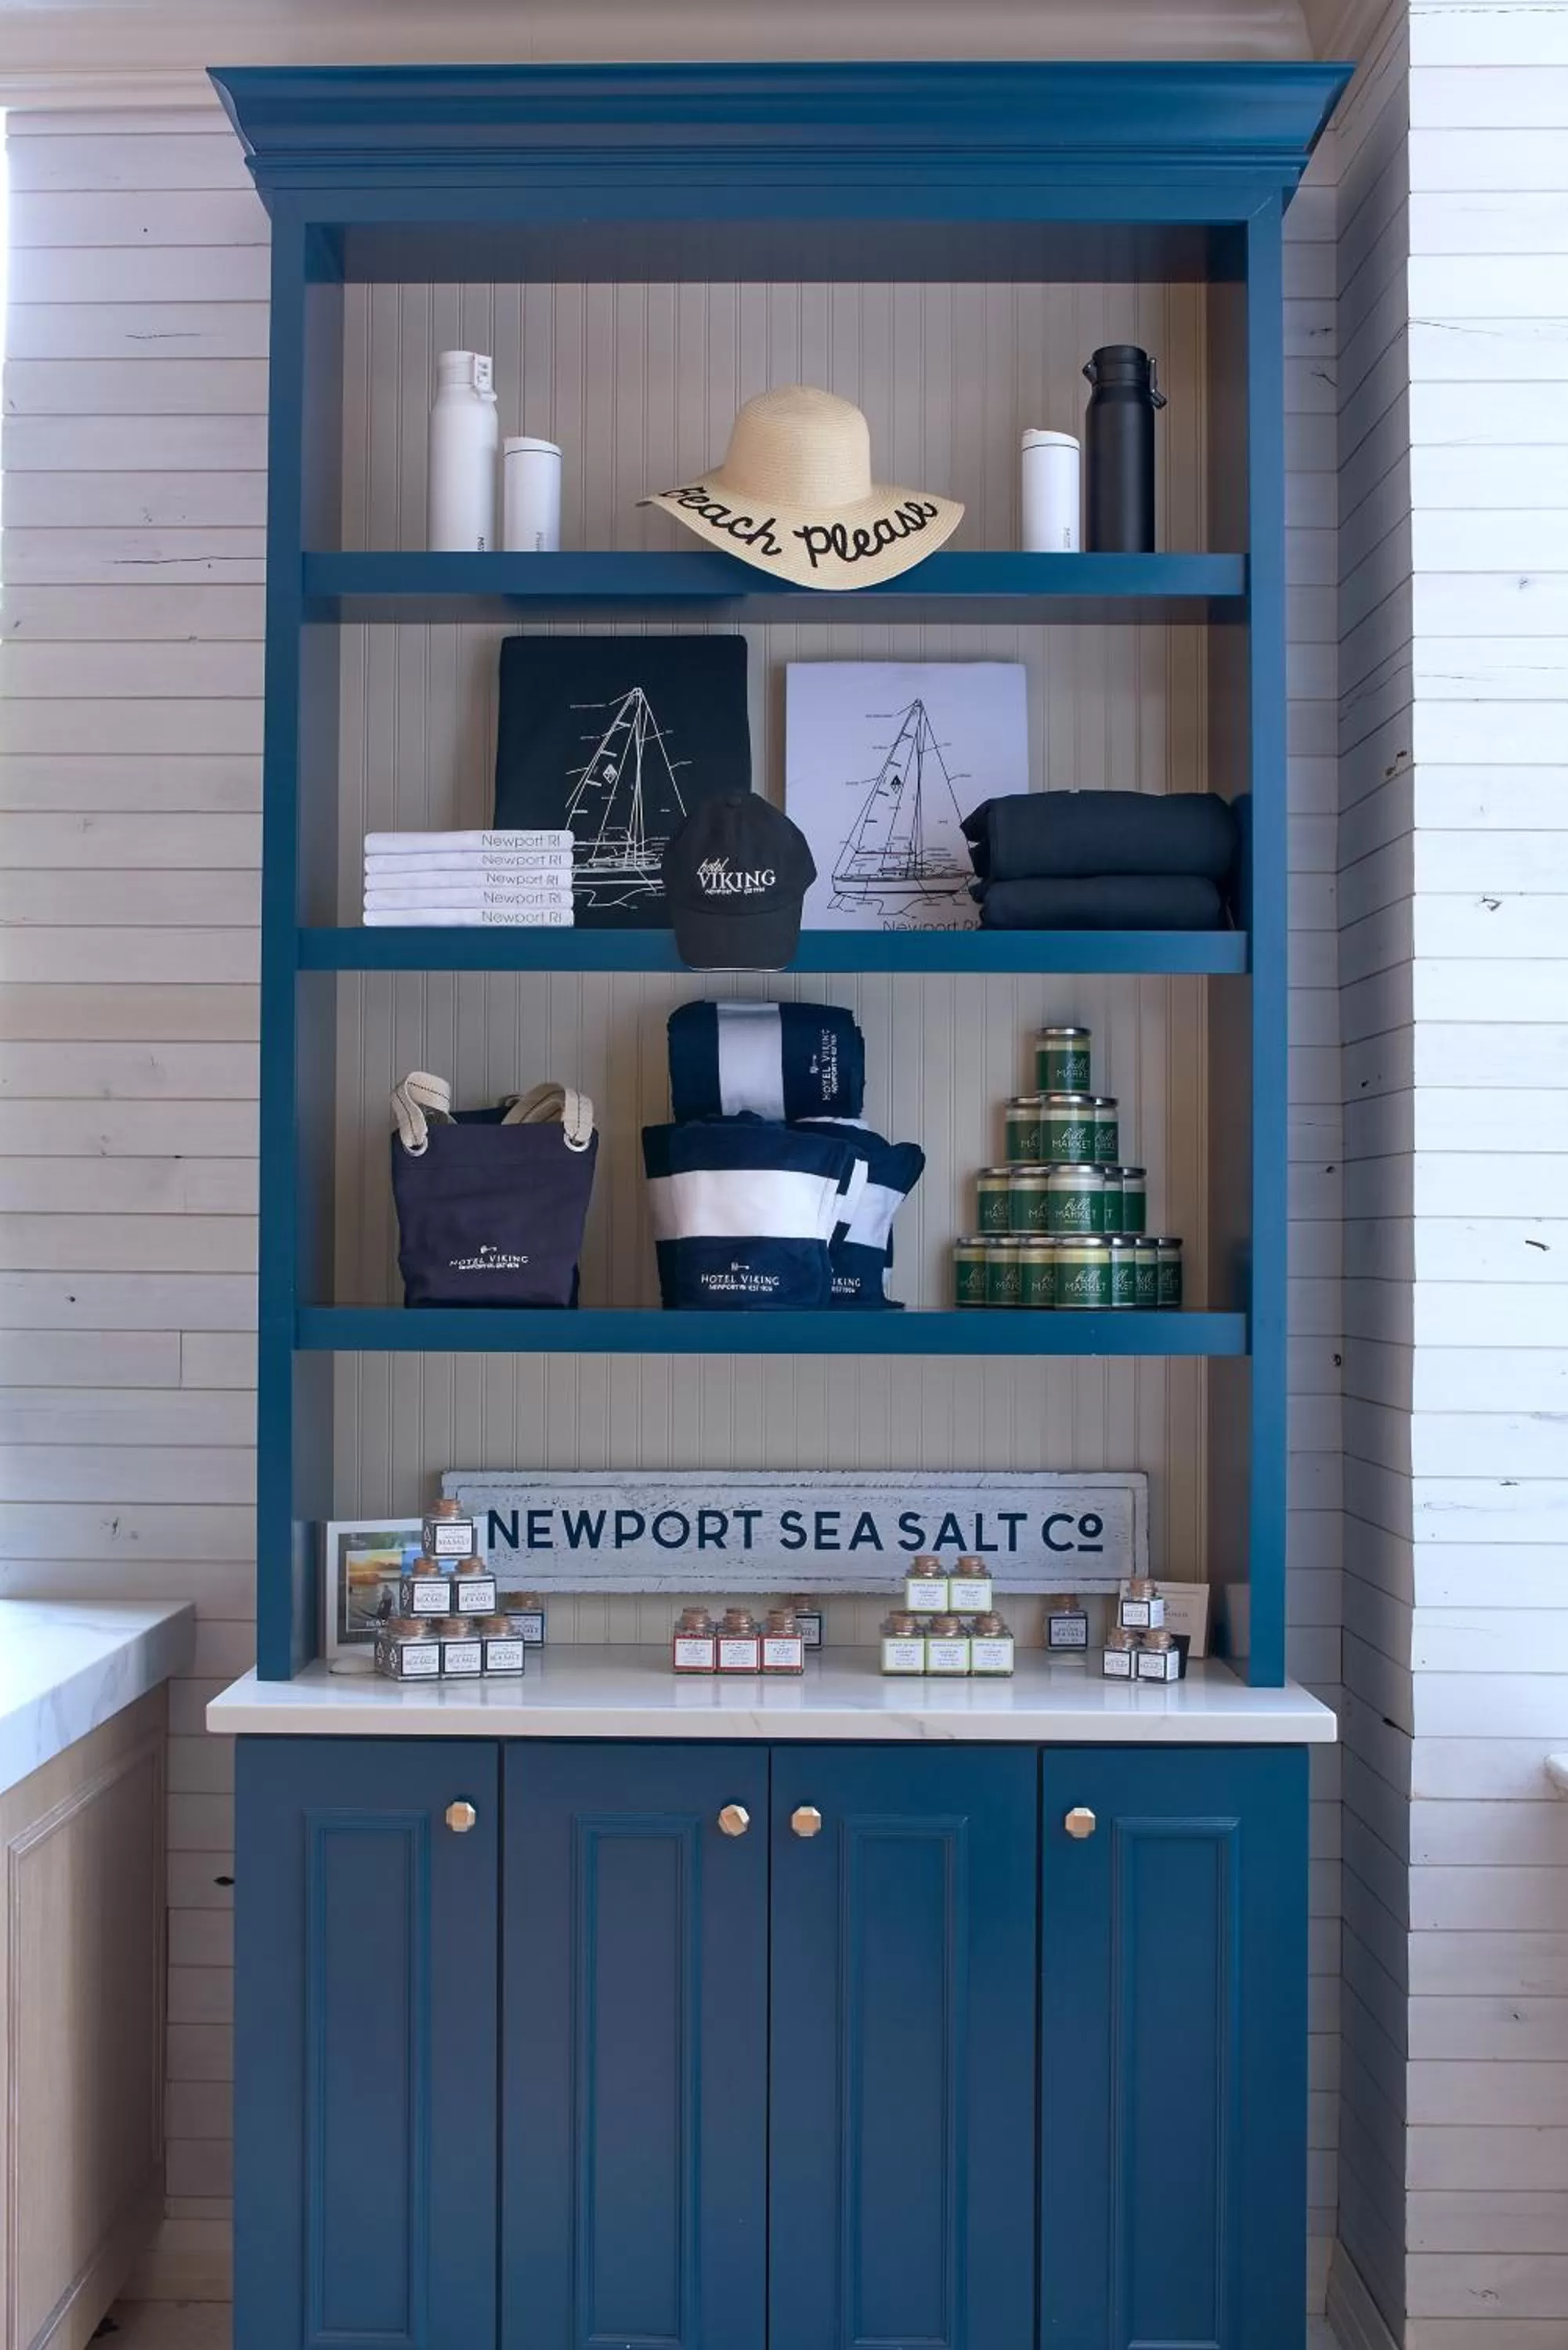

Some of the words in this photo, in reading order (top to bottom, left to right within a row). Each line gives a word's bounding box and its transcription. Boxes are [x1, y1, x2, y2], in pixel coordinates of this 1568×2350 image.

[659, 486, 782, 556] Beach
[482, 833, 544, 847] Newport
[547, 835, 561, 846] RI
[482, 855, 545, 866] Newport
[548, 855, 562, 865] RI
[486, 873, 543, 885] Newport
[546, 874, 559, 885] RI
[697, 869, 776, 893] VIKING
[483, 891, 544, 903] Newport
[547, 892, 562, 903] RI
[482, 911, 545, 924] Newport
[548, 912, 562, 923] RI
[1055, 1068, 1089, 1078] MARKE
[821, 1066, 831, 1101] HOTEL
[1051, 1140, 1091, 1149] MARKET
[1055, 1209, 1097, 1219] MARKET
[489, 1254, 529, 1264] VIKING
[700, 1274, 736, 1284] HOTEL
[739, 1274, 780, 1286] VIKING
[832, 1278, 862, 1287] IKING
[1064, 1282, 1107, 1292] MARKET
[487, 1509, 763, 1549] NEWPORT
[779, 1509, 884, 1550] SEA
[898, 1511, 1028, 1552] SALT
